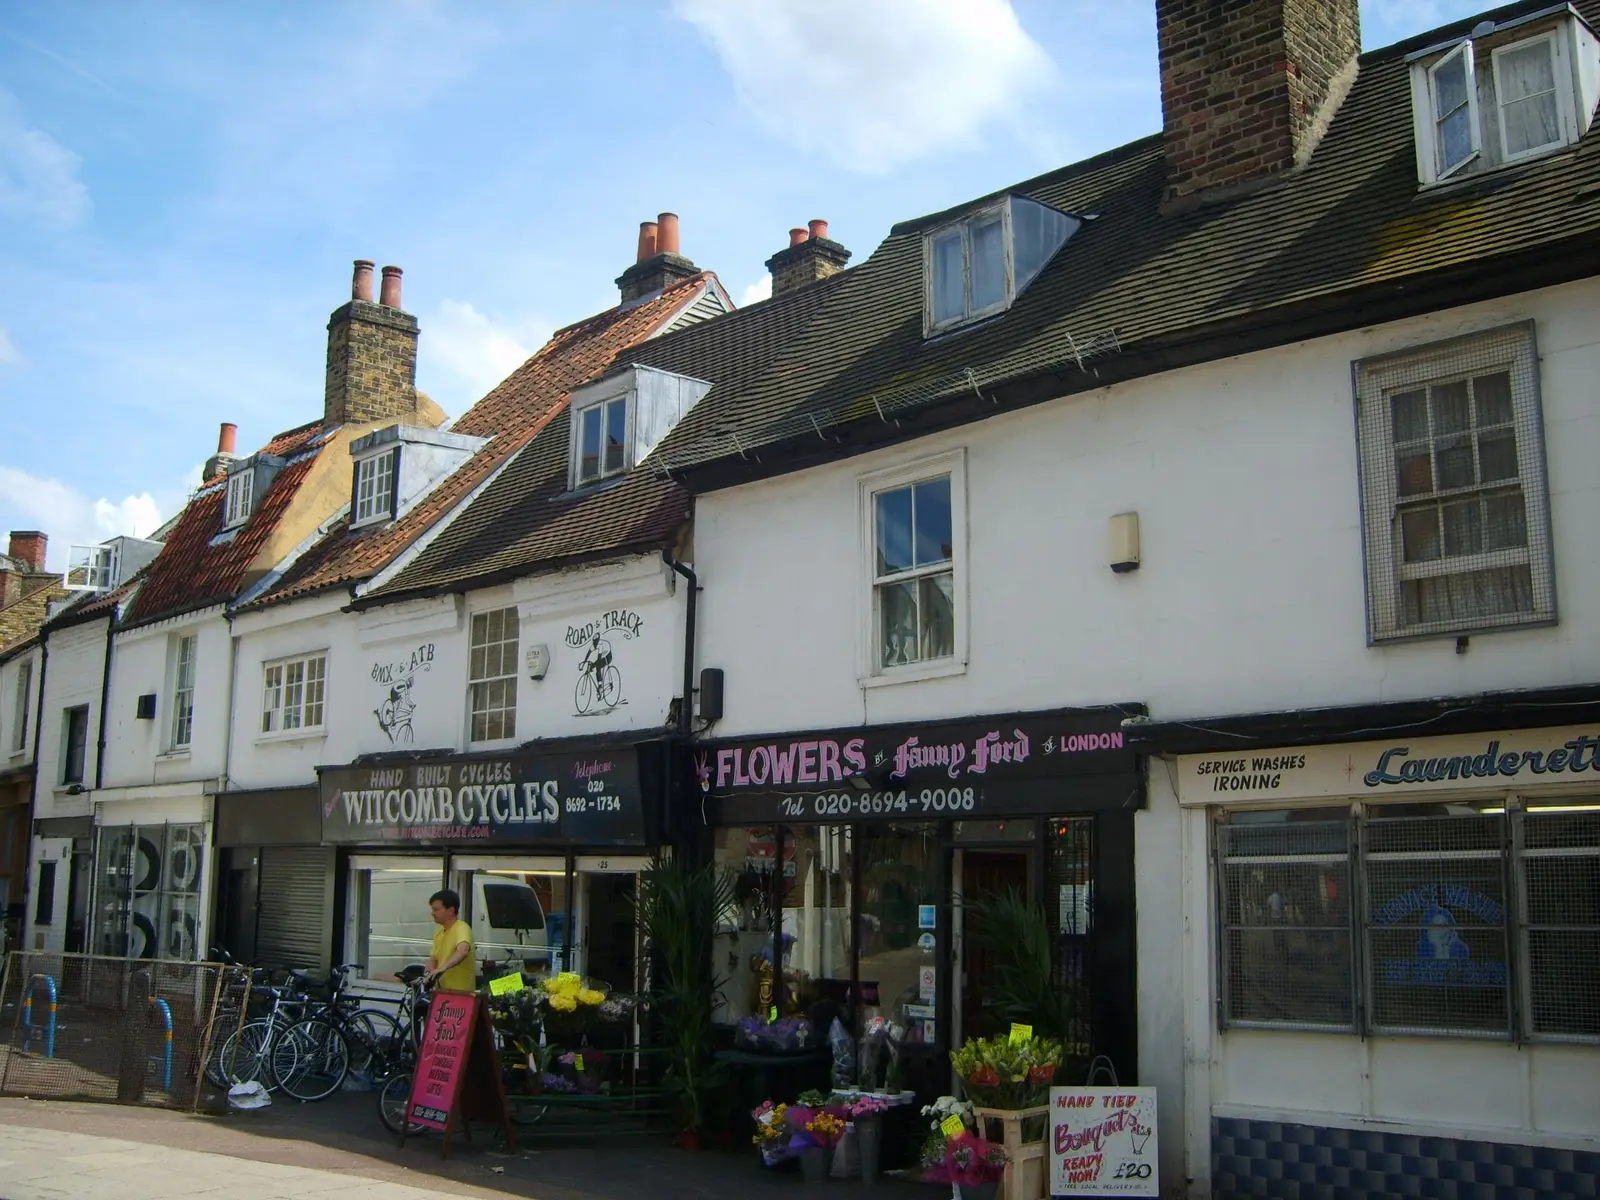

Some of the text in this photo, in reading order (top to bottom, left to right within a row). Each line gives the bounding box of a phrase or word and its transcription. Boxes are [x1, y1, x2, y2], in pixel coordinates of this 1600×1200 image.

[565, 623, 593, 645] ROAD
[603, 610, 643, 638] TRACK
[371, 663, 393, 683] BMX
[409, 643, 435, 671] ATB
[716, 738, 866, 787] FLOWERS
[874, 751, 884, 764] BY
[889, 736, 965, 779] Fanny
[967, 728, 1031, 774] Ford
[1060, 732, 1123, 752] LONDON
[1197, 755, 1306, 775] SERVICE WASHES
[370, 762, 512, 788] HAND BUILT CYCLES
[587, 781, 604, 792] 020
[1213, 774, 1281, 792] IRONING
[342, 786, 455, 826] WITCOMB
[456, 780, 560, 825] CYCLES
[782, 787, 974, 816] Tel 020-8694-9008
[434, 1000, 466, 1025] Fanny
[433, 1021, 456, 1042] Ford
[1056, 1094, 1137, 1109] HAND TIED
[1054, 1109, 1138, 1155] Bouquets
[1063, 1153, 1103, 1171] READY
[1113, 1162, 1152, 1179] £20
[1068, 1167, 1101, 1183] NOW!
